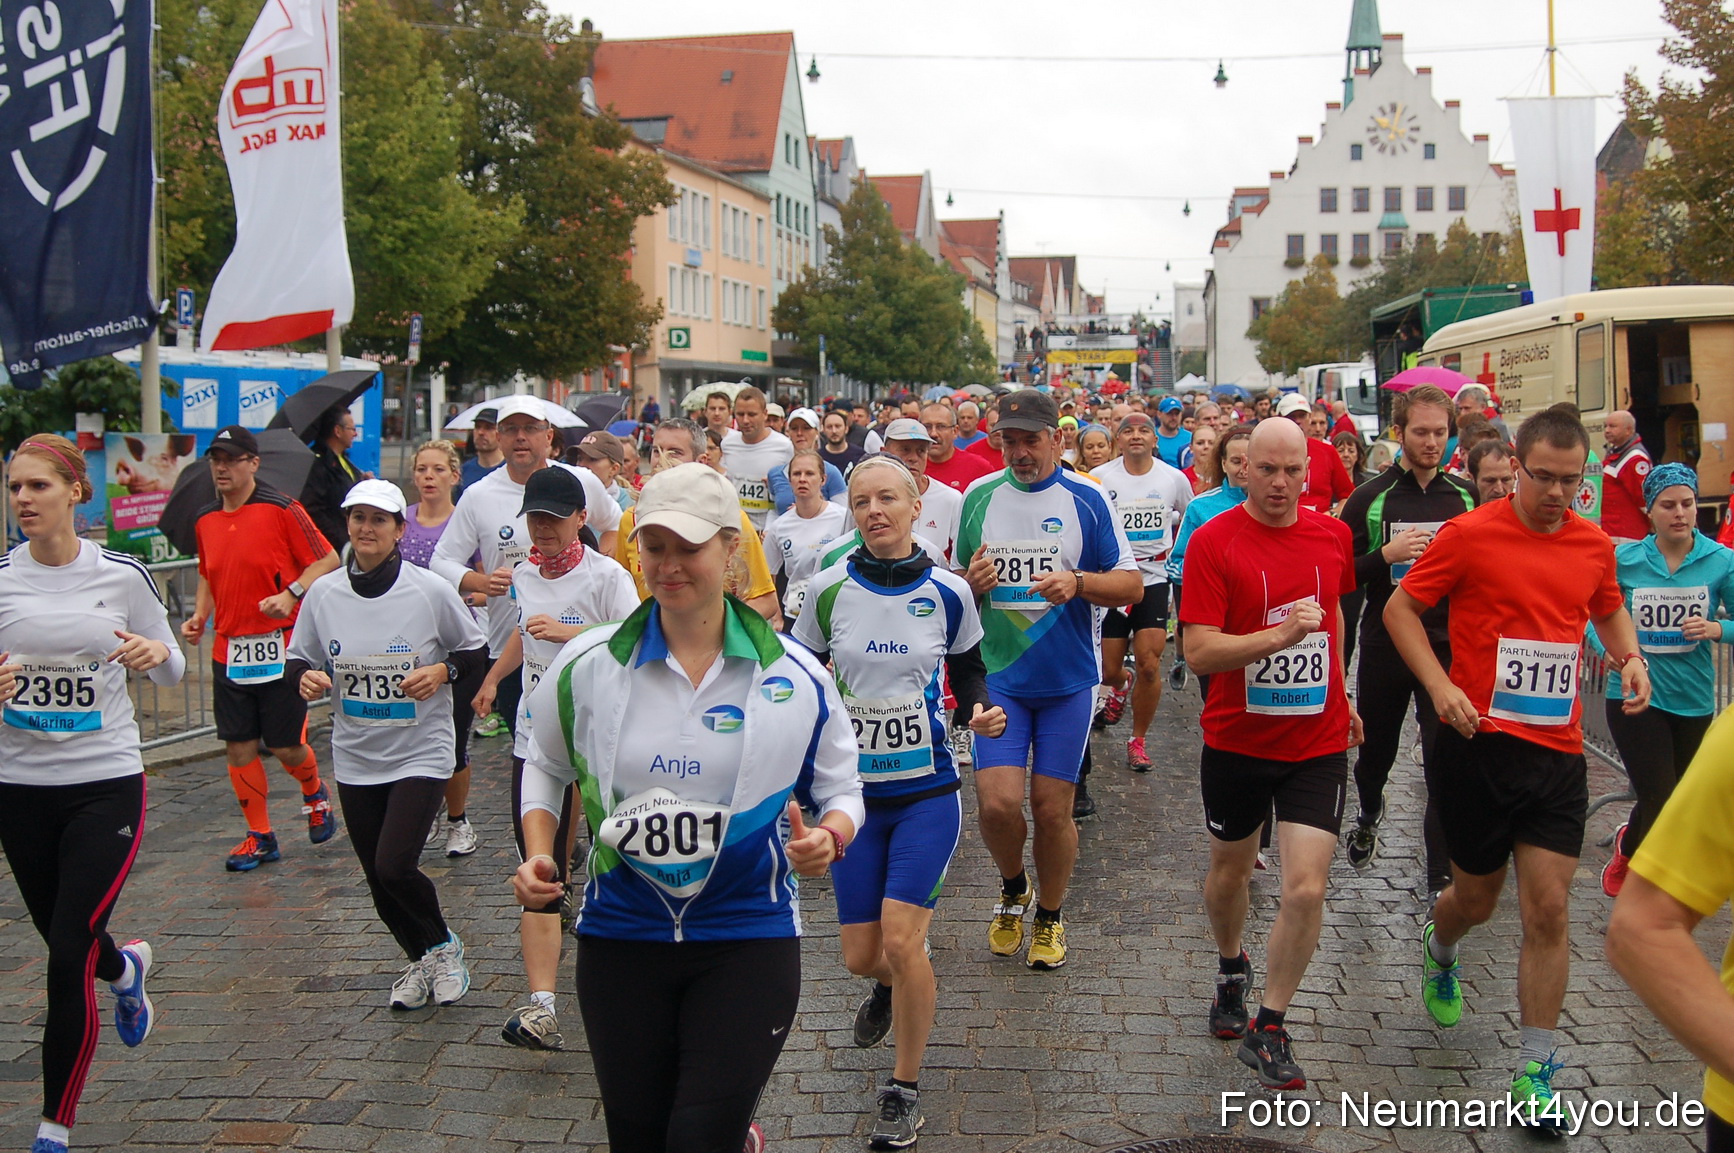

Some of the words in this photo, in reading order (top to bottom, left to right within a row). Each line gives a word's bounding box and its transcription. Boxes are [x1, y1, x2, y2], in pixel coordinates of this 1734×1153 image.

[671, 329, 688, 347] D
[1500, 343, 1549, 370] Bayerisches
[1123, 511, 1163, 530] 2825
[497, 540, 519, 548] PARTL
[993, 557, 1054, 583] 2815
[1011, 589, 1034, 600] Jens
[233, 641, 279, 663] 2189
[865, 640, 909, 654] Anke
[1500, 646, 1531, 657] PARTL
[1532, 650, 1570, 660] Neumarkt
[38, 664, 86, 673] Neumarkt
[335, 663, 360, 671] PARTL
[1254, 652, 1324, 685] 2328
[1505, 660, 1572, 694] 3119
[11, 675, 95, 707] 2395
[344, 673, 406, 700] 2133
[1271, 692, 1311, 704] Robert
[362, 705, 391, 717] Astrid
[869, 704, 912, 715] Neumarkt
[28, 715, 75, 729] Marina
[850, 714, 923, 750] 2795
[649, 755, 701, 779] Anja
[871, 757, 901, 770] Anke
[615, 811, 722, 857] 2801
[656, 867, 692, 888] Anja
